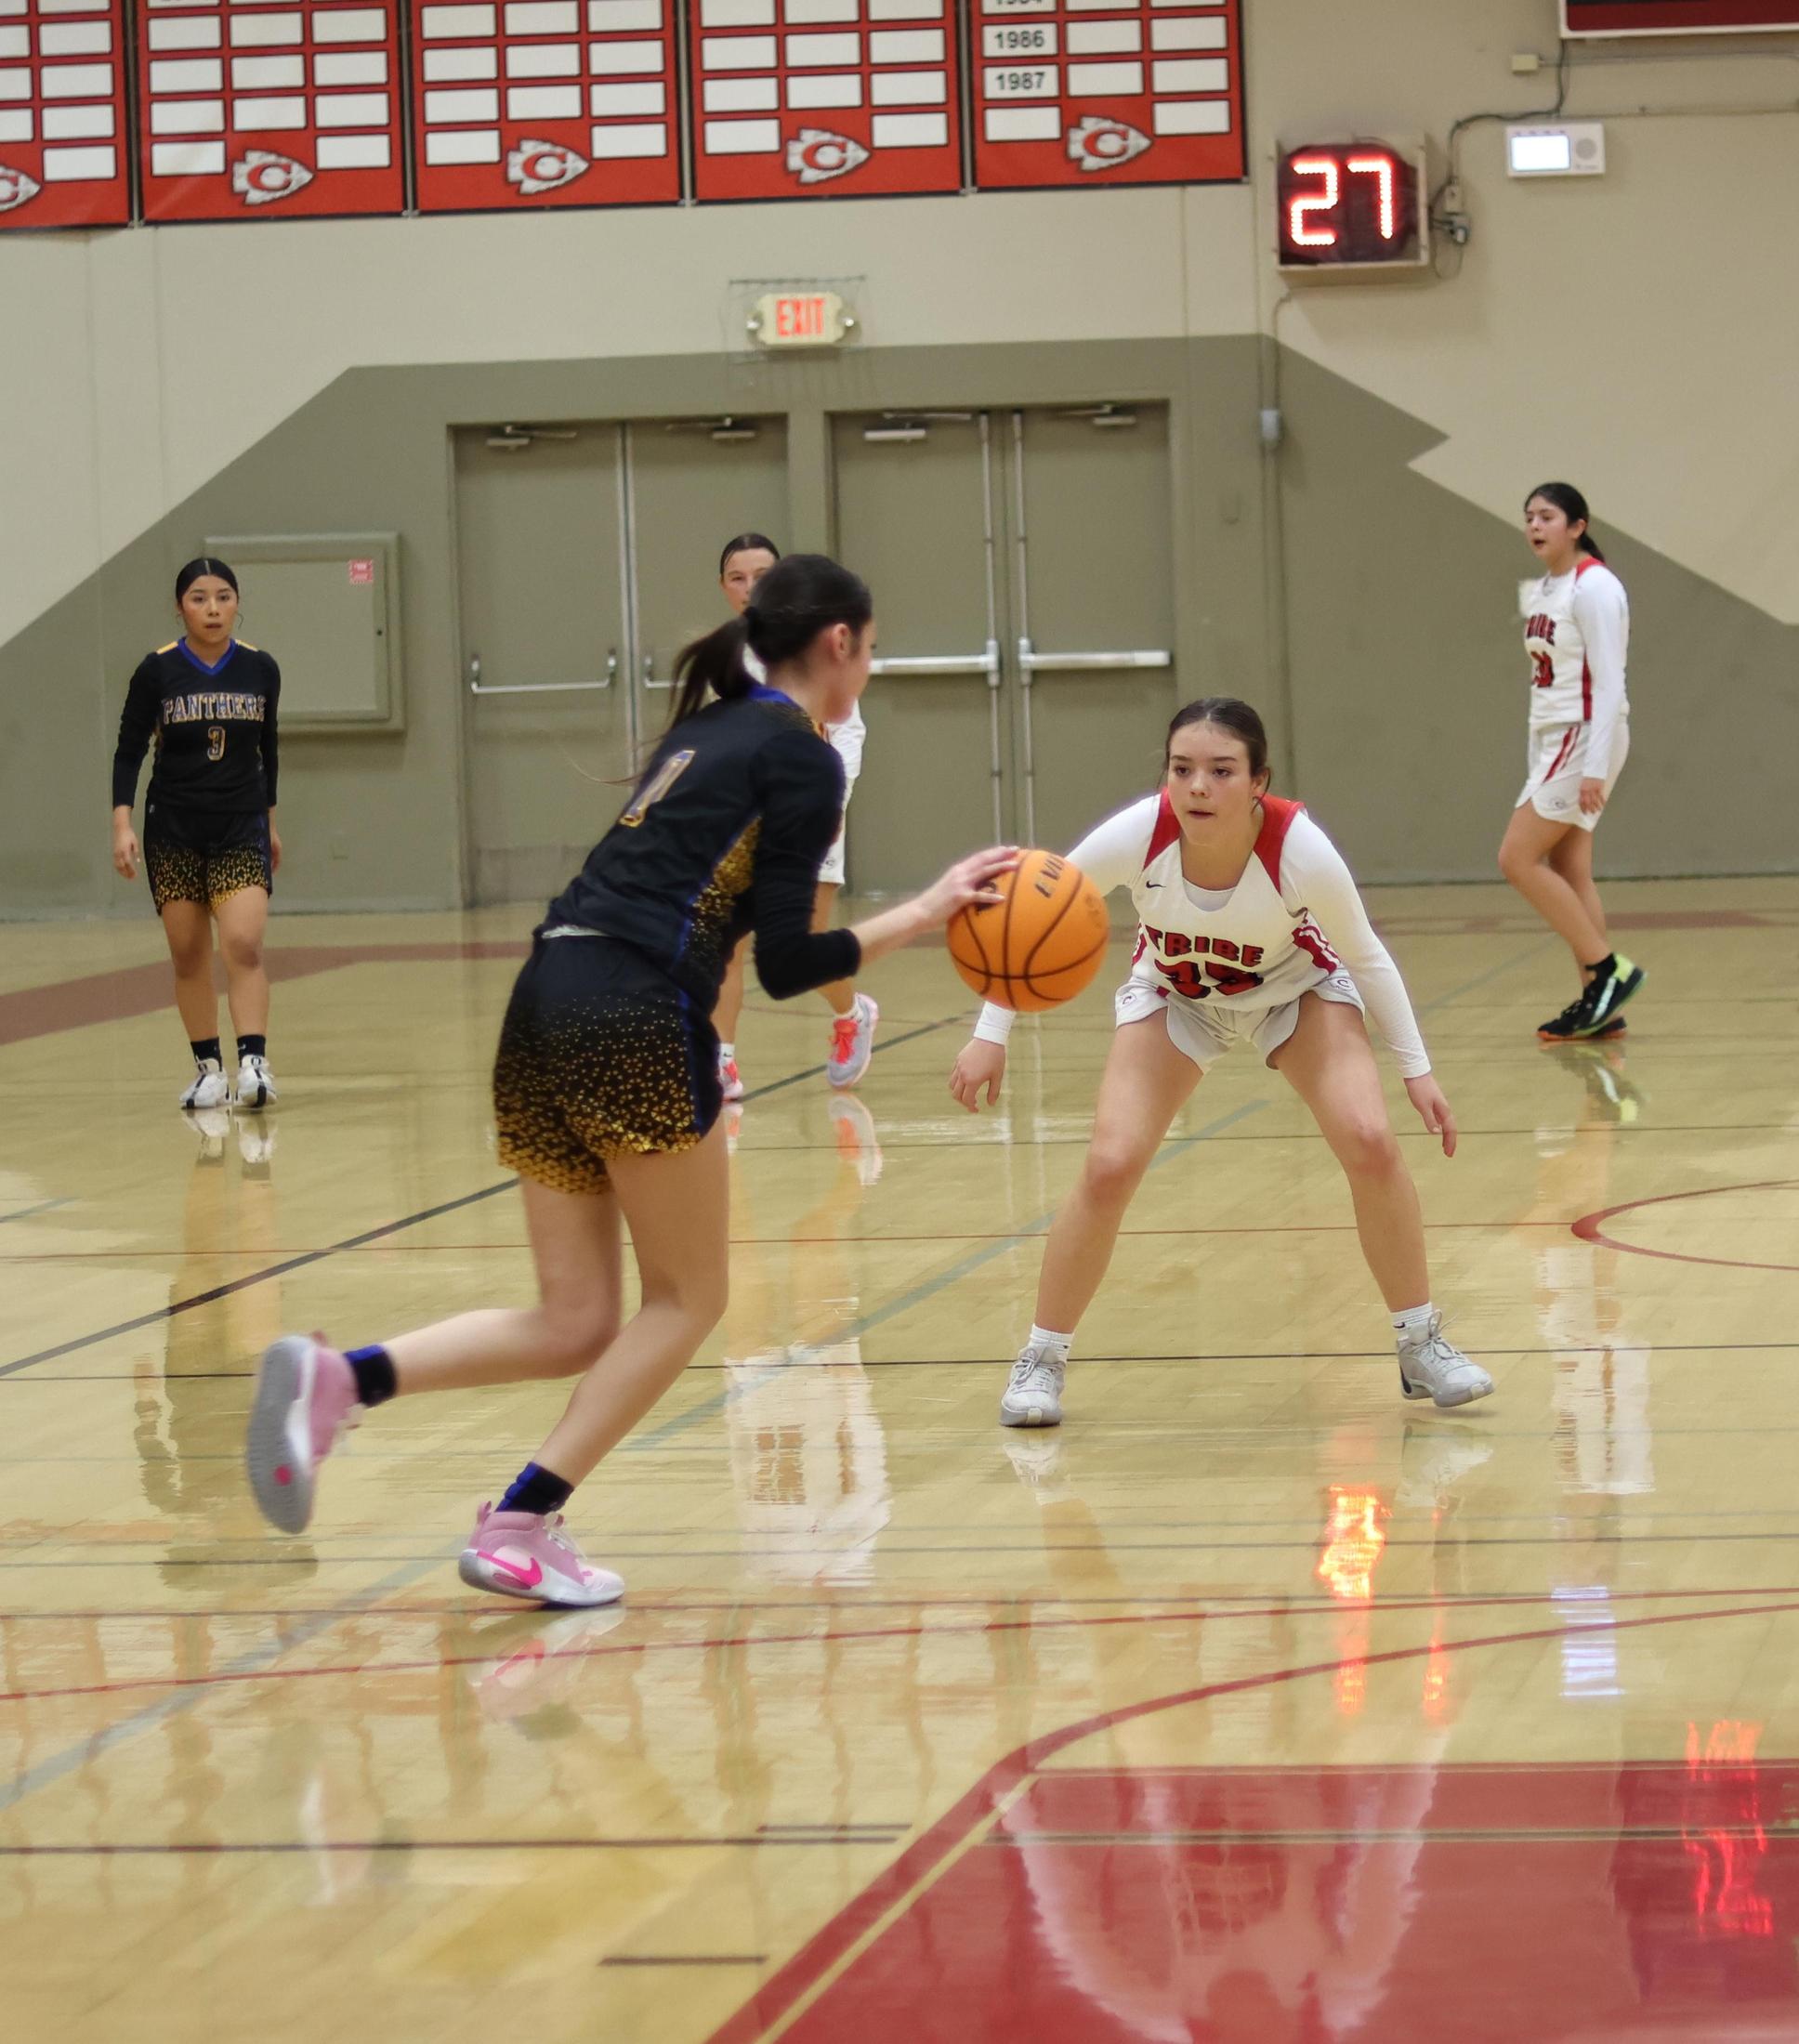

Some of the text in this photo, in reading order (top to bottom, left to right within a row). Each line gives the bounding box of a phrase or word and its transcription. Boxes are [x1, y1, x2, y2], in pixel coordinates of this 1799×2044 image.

[994, 29, 1045, 49] 1986
[995, 71, 1046, 90] 1987
[1290, 156, 1394, 246] 27
[775, 296, 826, 336] EXIT
[161, 691, 267, 725] PANTHERS
[206, 726, 226, 761] 3
[1144, 924, 1265, 968] TRIBE
